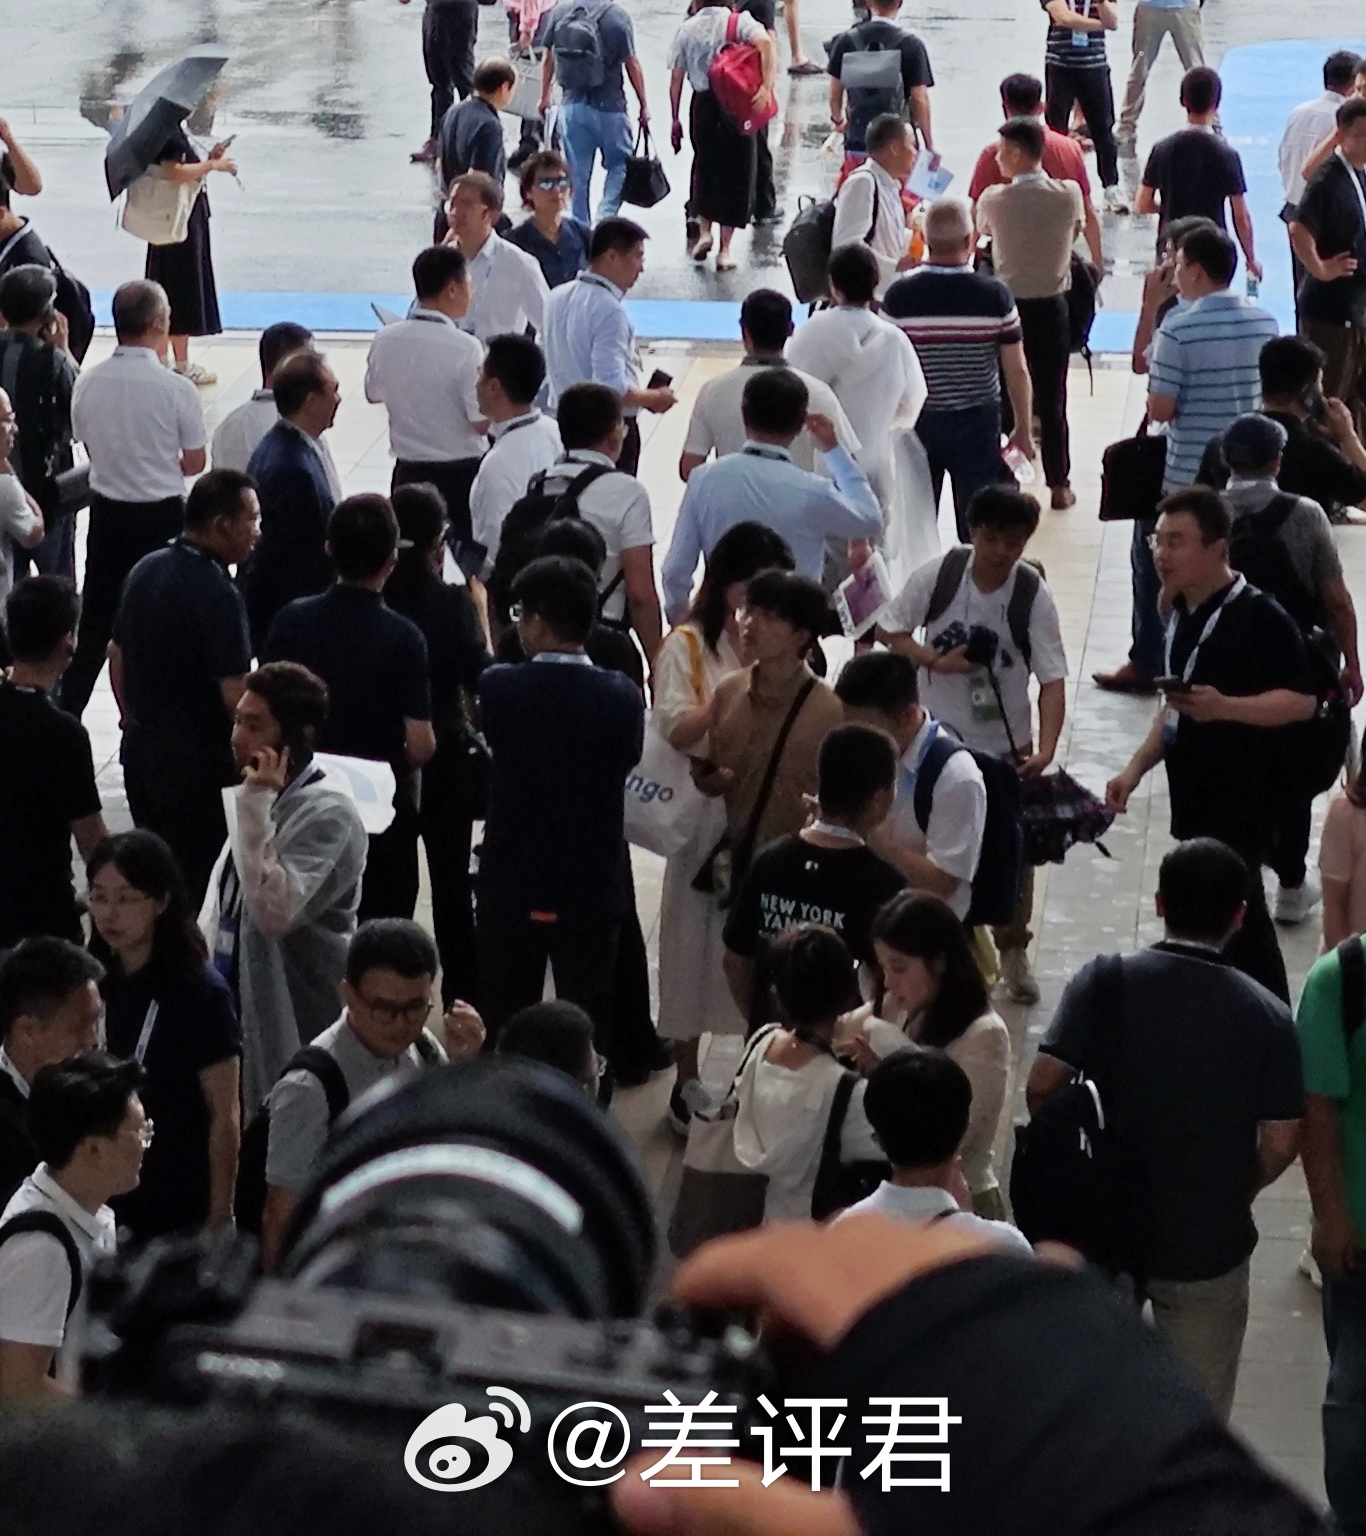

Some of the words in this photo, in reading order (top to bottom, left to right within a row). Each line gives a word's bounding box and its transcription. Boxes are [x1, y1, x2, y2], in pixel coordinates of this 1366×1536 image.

[625, 775, 673, 803] ngo
[761, 894, 796, 916] NEW
[800, 902, 846, 930] YORK
